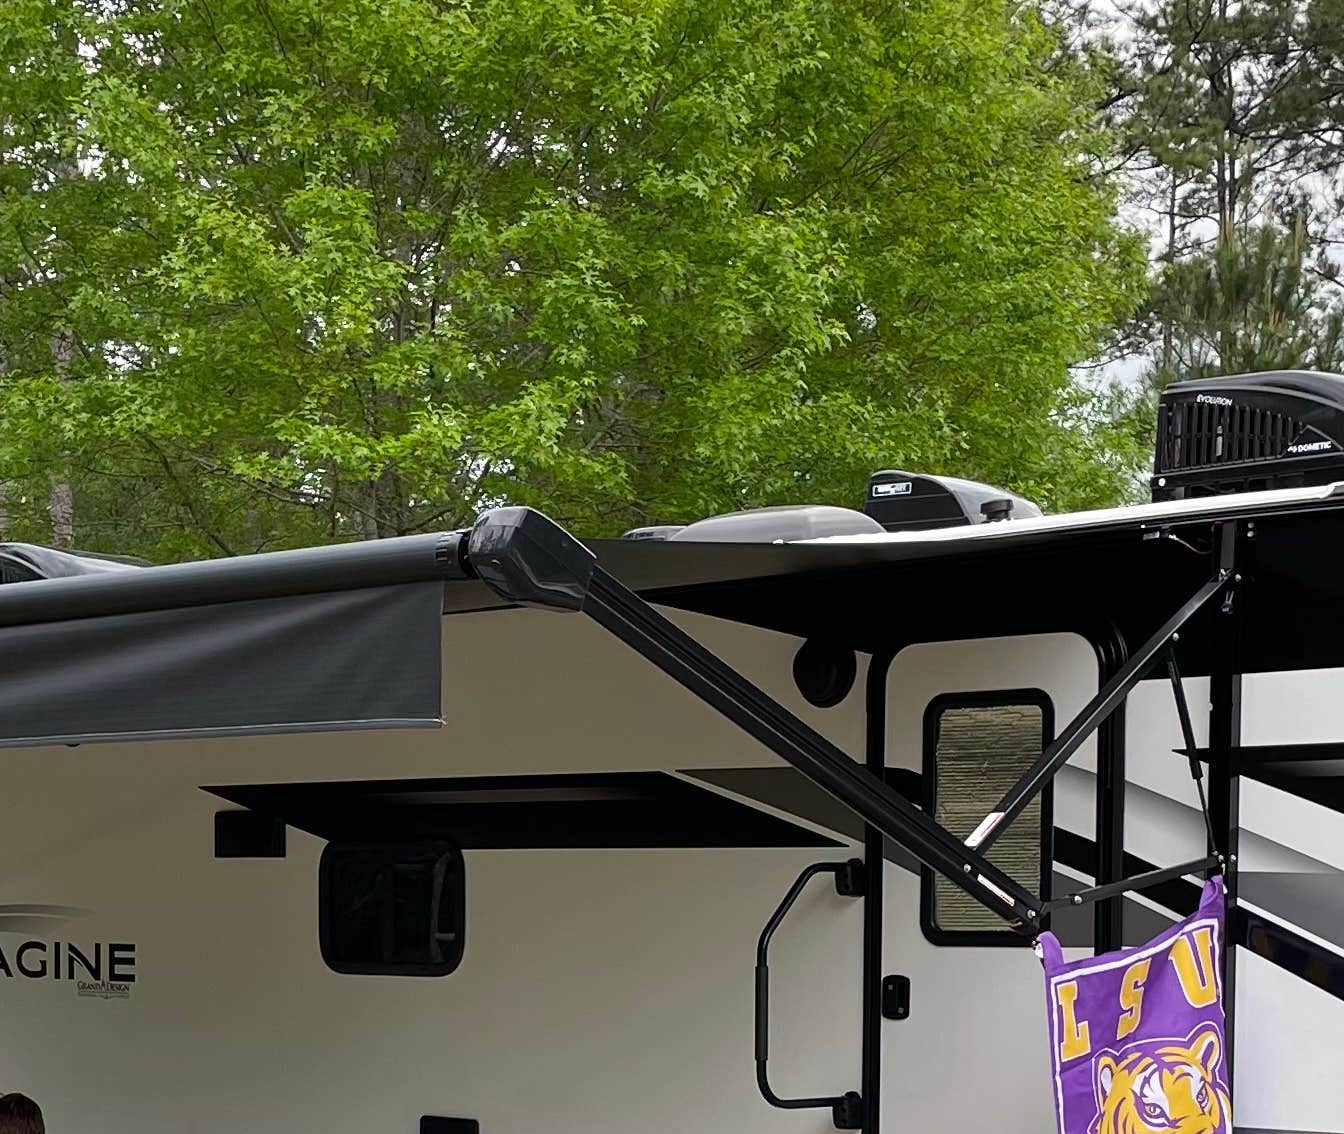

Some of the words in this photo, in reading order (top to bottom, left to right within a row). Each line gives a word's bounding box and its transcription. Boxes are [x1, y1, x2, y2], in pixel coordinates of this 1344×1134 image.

[1297, 441, 1332, 452] DOMETIC
[106, 982, 130, 992] DESIGN
[1057, 928, 1219, 1062] LSU
